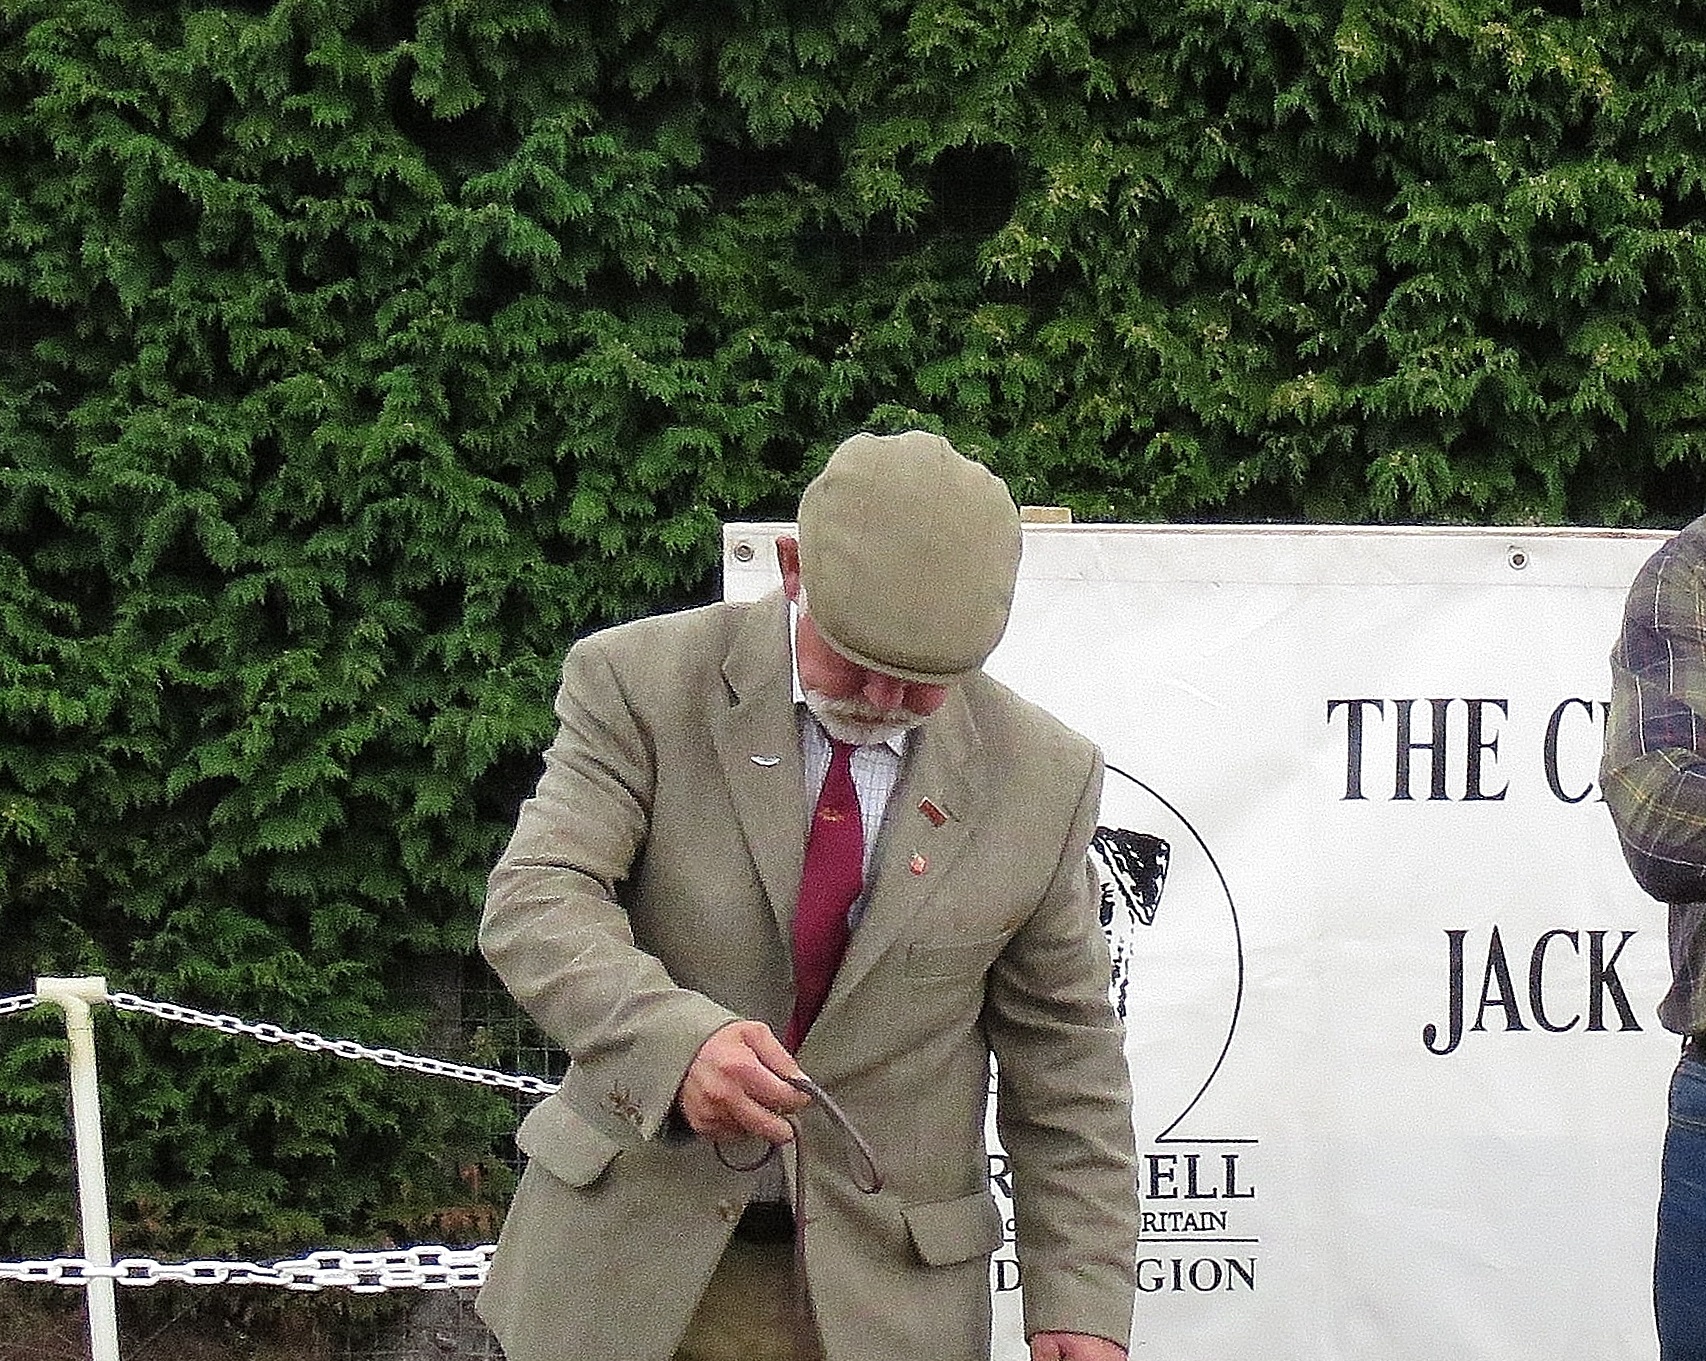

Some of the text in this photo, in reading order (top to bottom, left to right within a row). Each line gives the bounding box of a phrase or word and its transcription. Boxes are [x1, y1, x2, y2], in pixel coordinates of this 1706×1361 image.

[1327, 698, 1510, 802] THE
[1423, 924, 1644, 1056] JACK
[1141, 1211, 1228, 1232] RITAIN
[1136, 1258, 1258, 1292] GION
